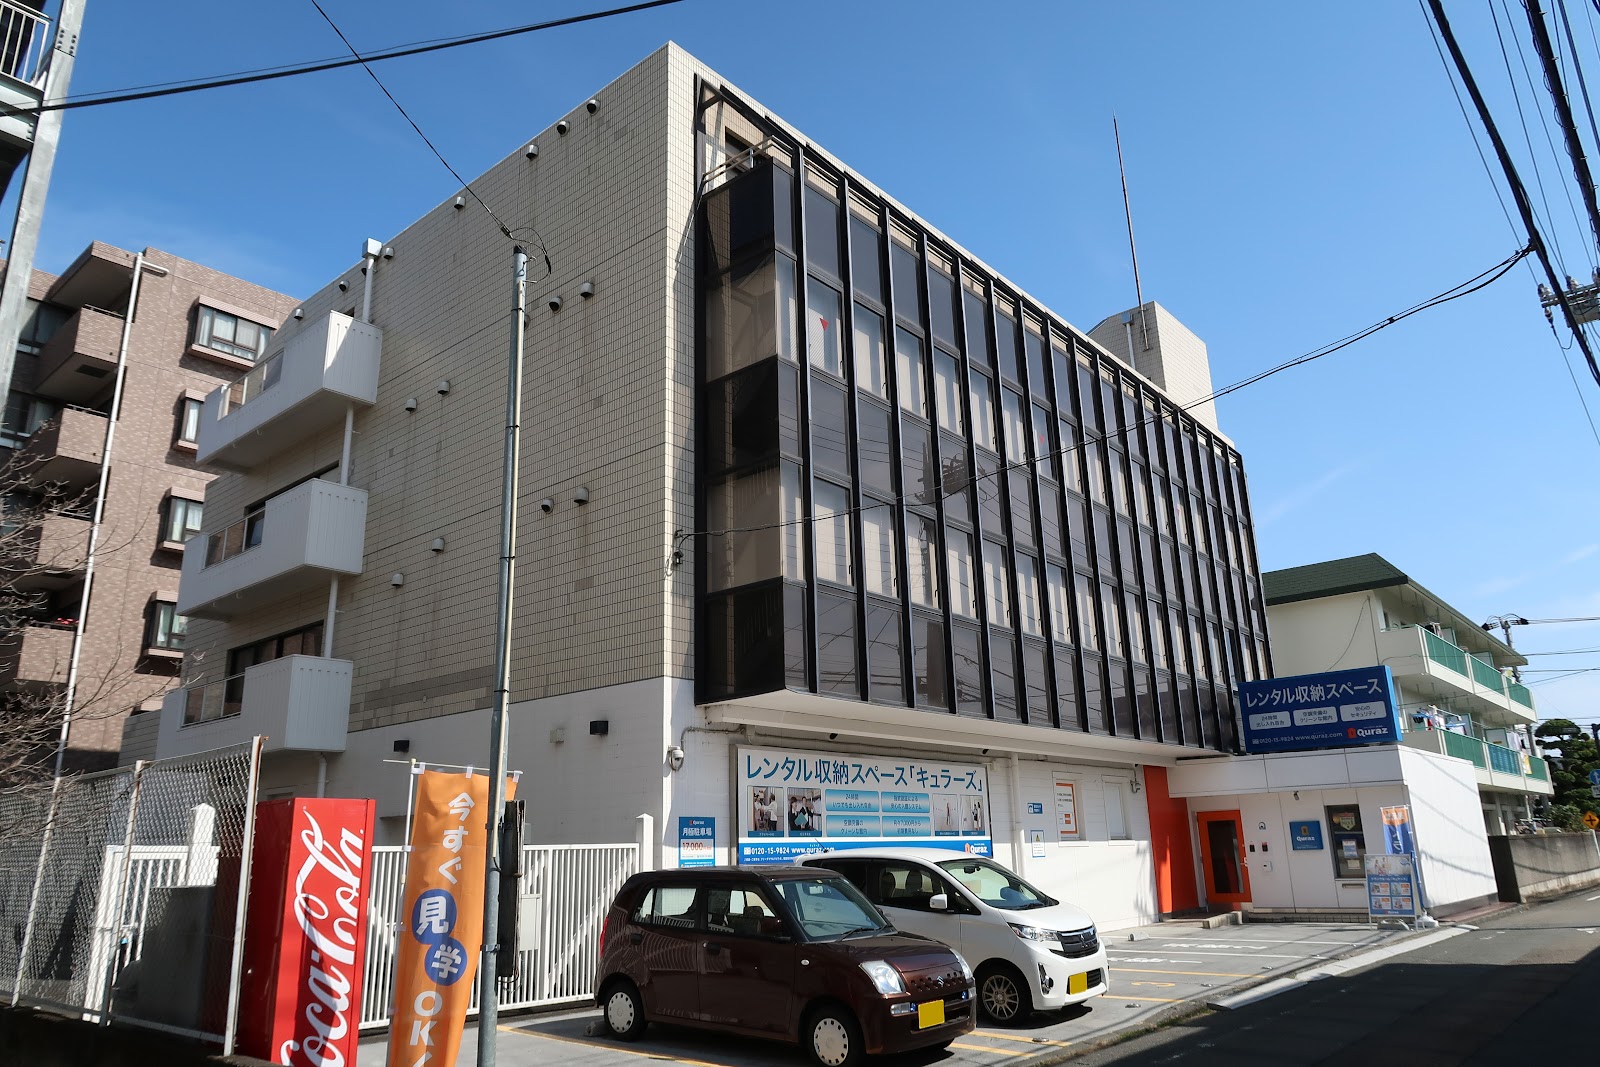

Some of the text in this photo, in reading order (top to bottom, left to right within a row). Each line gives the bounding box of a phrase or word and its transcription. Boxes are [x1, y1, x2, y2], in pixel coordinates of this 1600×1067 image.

[1246, 678, 1382, 707] レンタル収納スペース
[1295, 732, 1342, 740] www.quraz.com
[1356, 727, 1388, 737] Quraz
[751, 847, 790, 855] 0120-15-9824
[970, 845, 988, 854] Quraz
